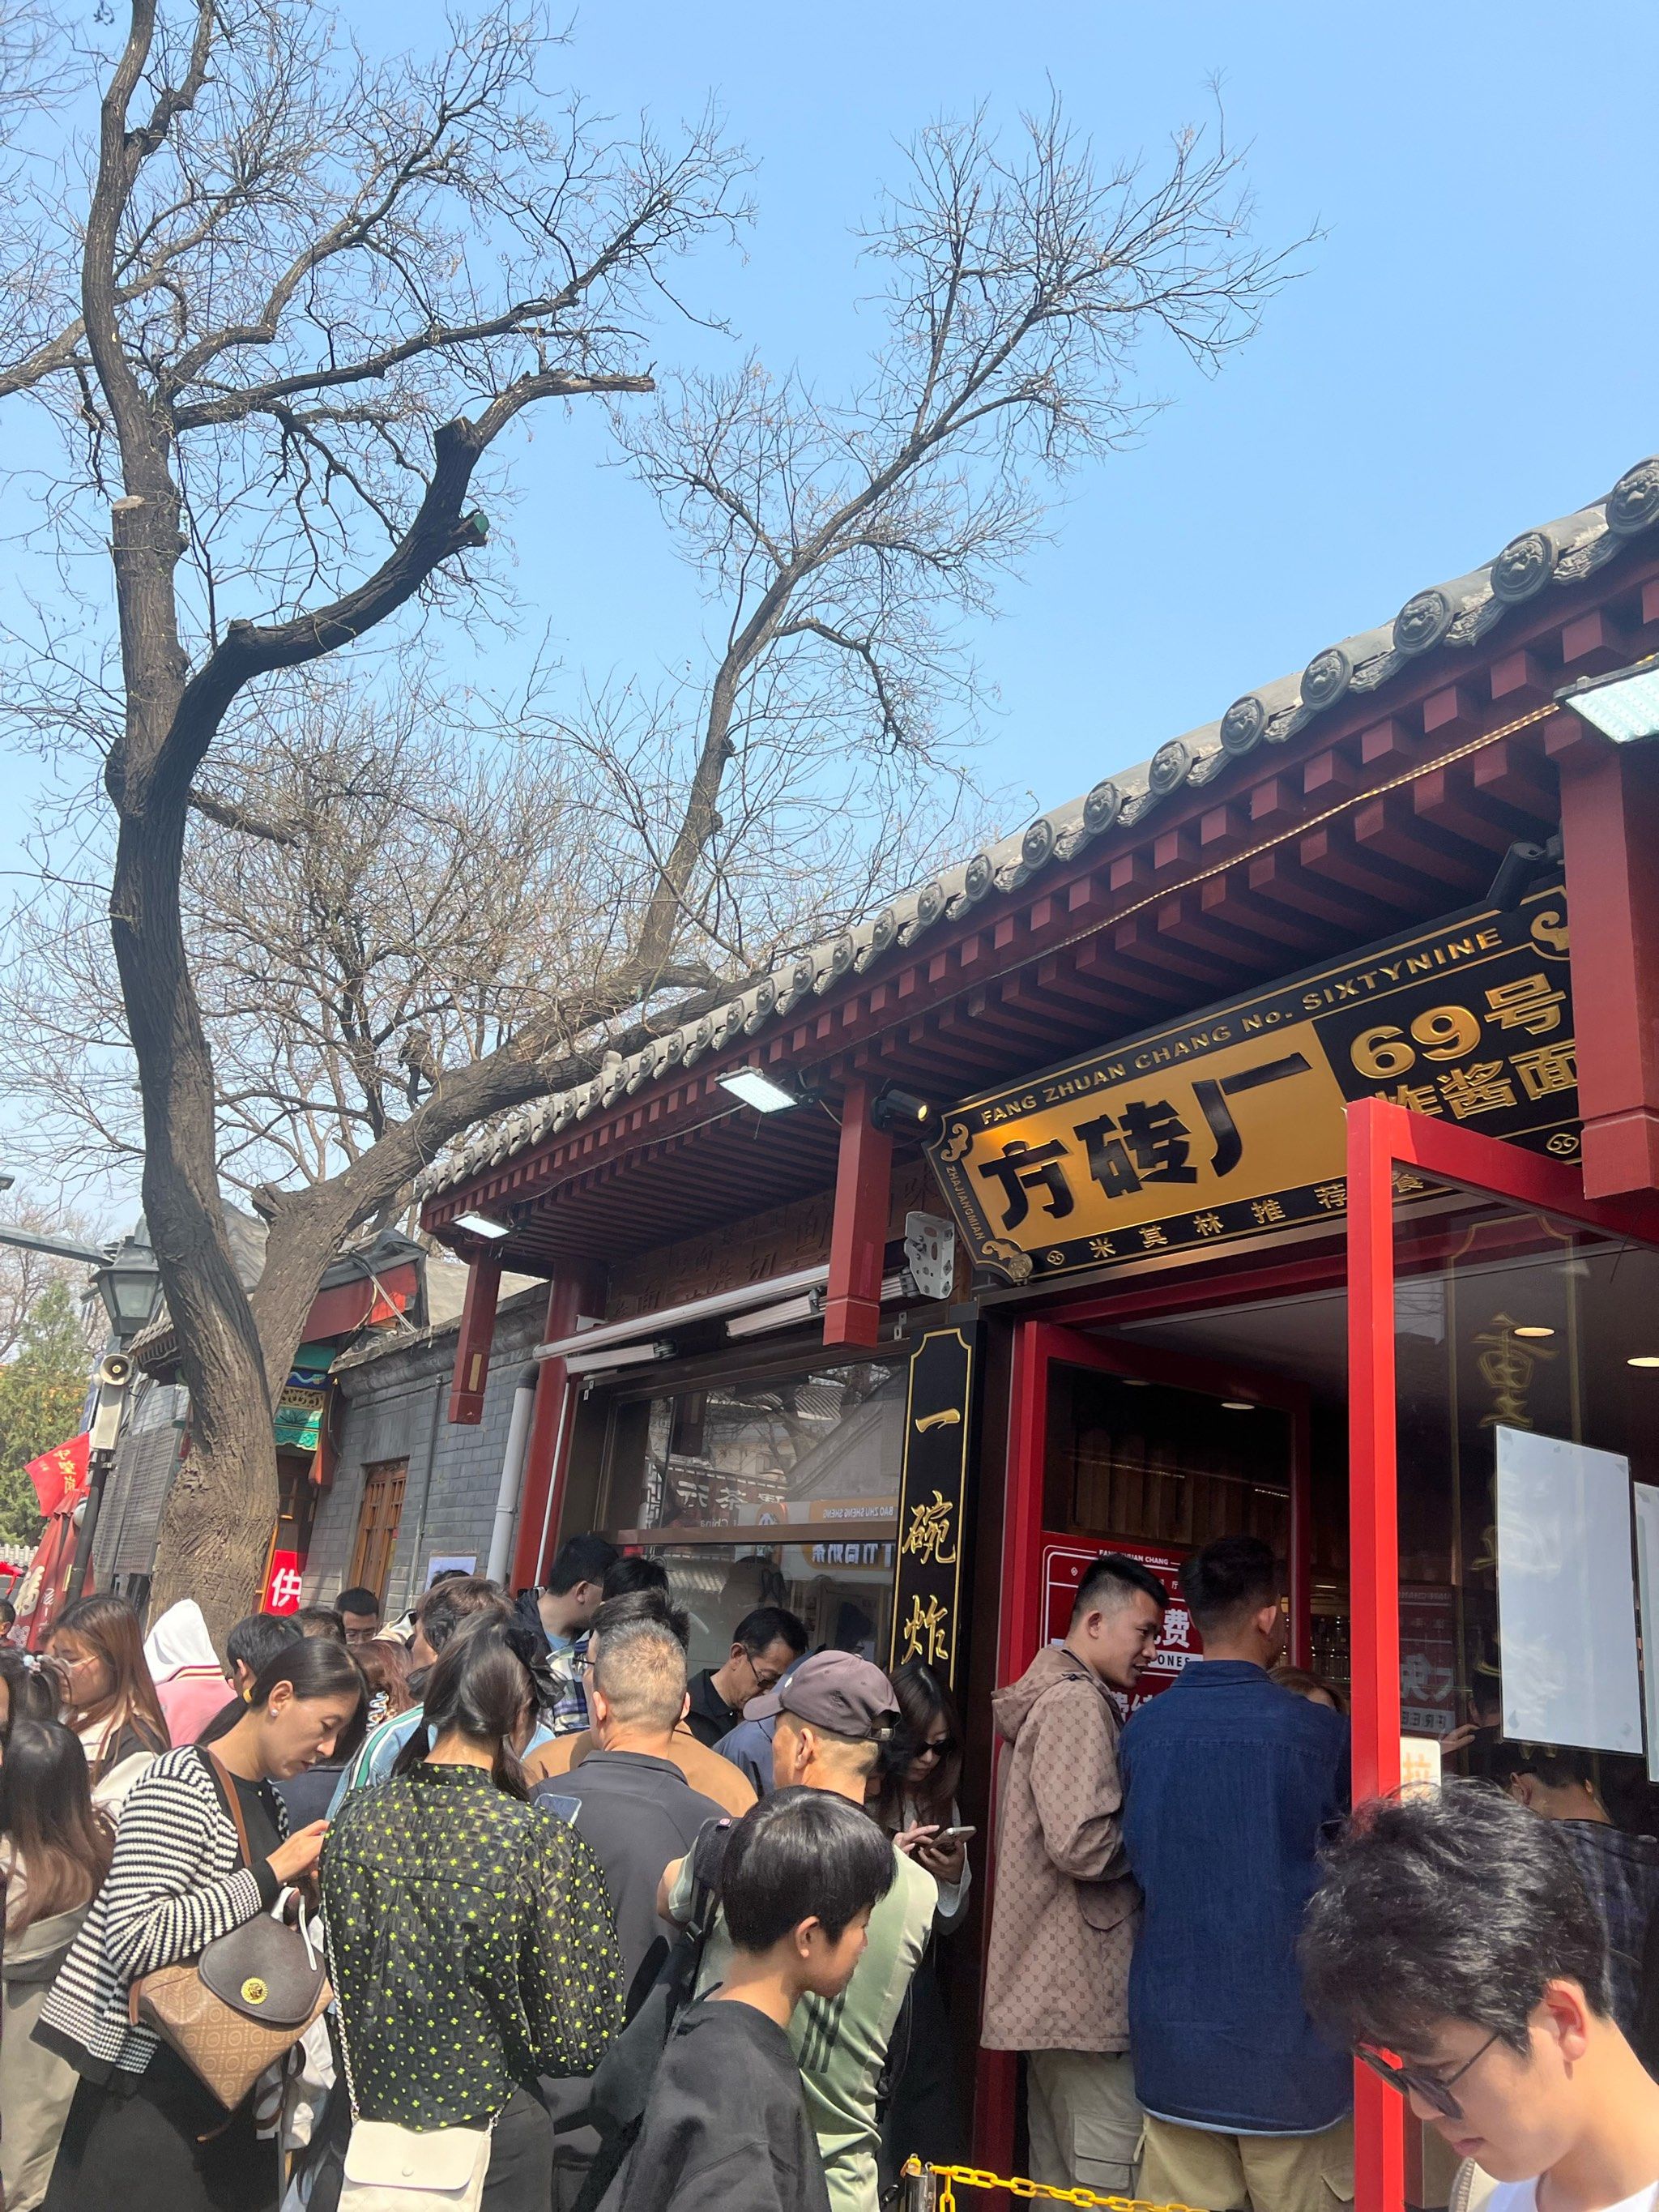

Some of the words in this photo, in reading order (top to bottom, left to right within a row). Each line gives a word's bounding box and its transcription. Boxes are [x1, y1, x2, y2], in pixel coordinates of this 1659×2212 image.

[981, 1095, 1037, 1125] FANG
[1043, 1063, 1127, 1104] ZHUAN
[1134, 1027, 1231, 1070] CHANG
[1241, 1010, 1293, 1033] No.
[1302, 928, 1503, 1011] SIXTYNINE
[1350, 973, 1567, 1079] 69号
[977, 1051, 1312, 1231] 方砖厂
[945, 1165, 986, 1241] ZHAJIANGMIAN
[901, 1407, 961, 1666] 一碗炸
[1145, 1556, 1169, 1565] CHANG
[1154, 1608, 1191, 1649] 费
